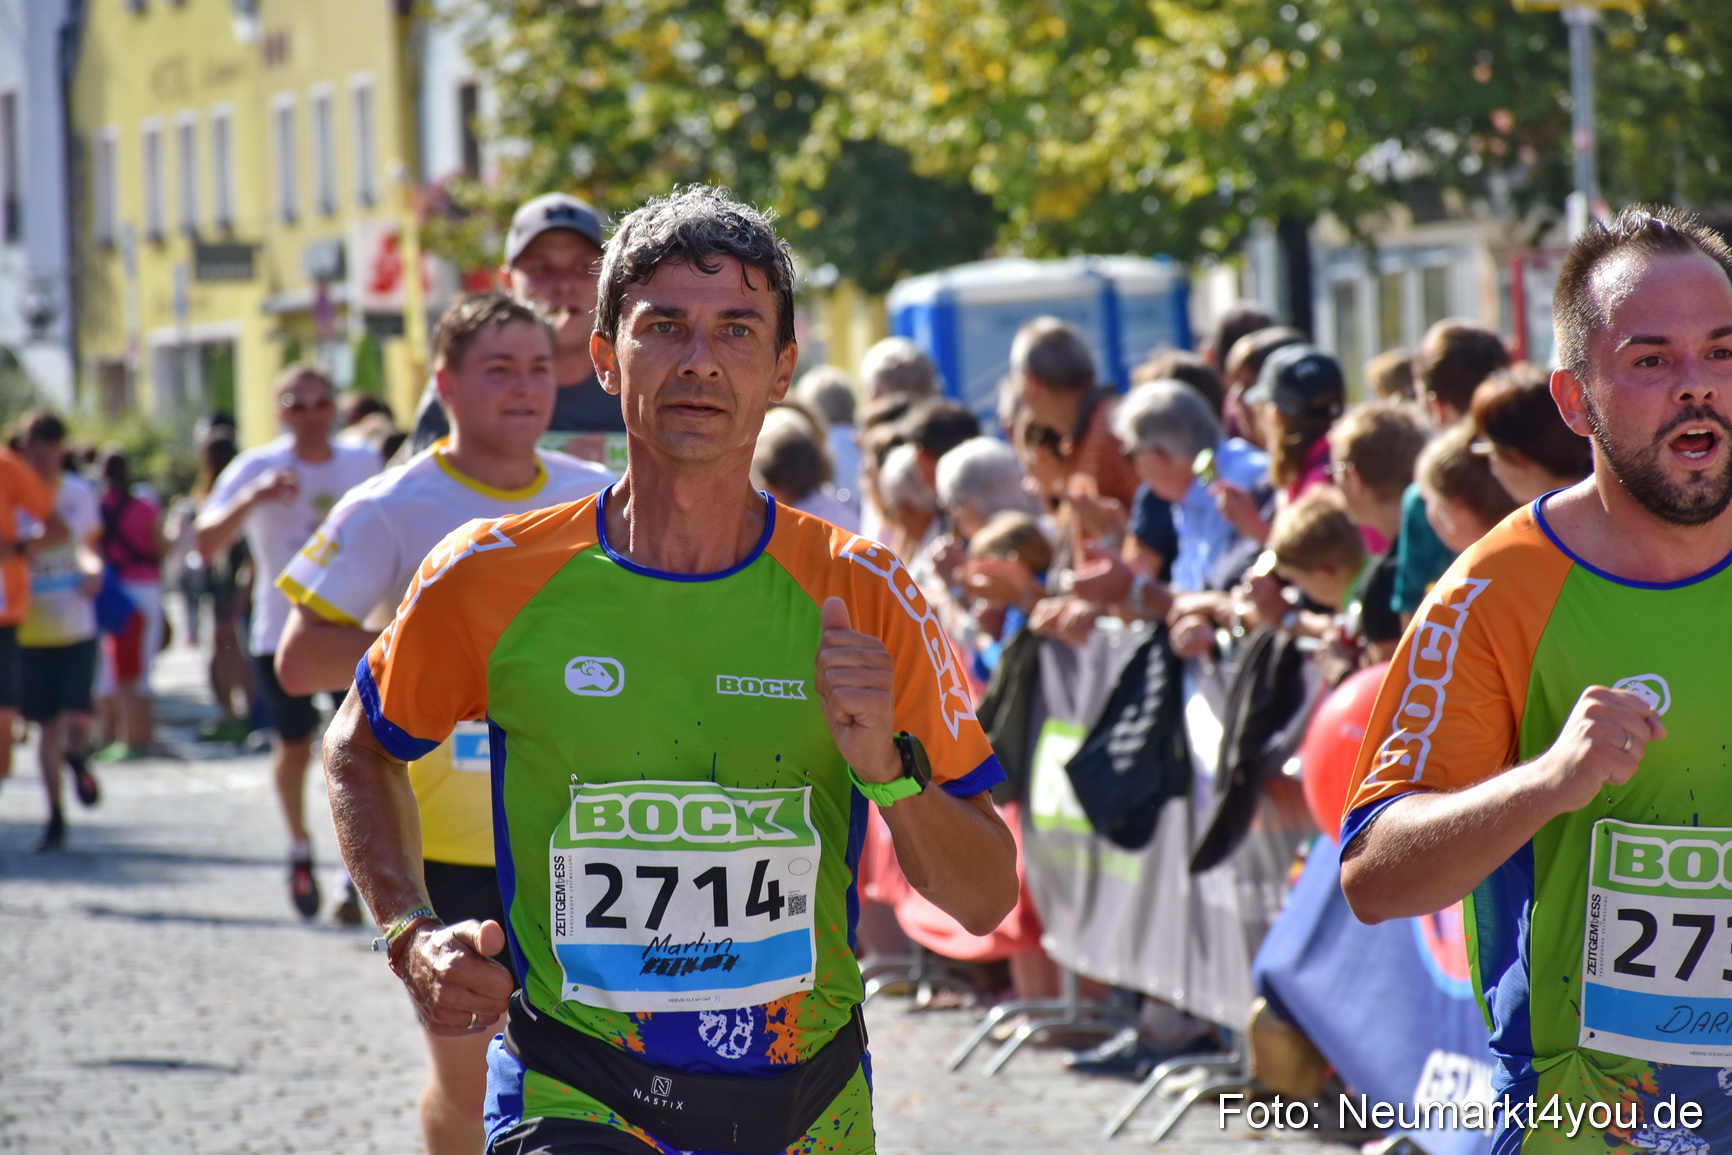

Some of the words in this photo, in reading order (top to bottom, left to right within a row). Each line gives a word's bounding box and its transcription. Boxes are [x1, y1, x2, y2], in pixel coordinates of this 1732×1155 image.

[839, 535, 978, 741] BOCK
[716, 674, 808, 700] BOCK
[1367, 578, 1492, 784] BOCK
[569, 792, 798, 843] BOCK
[1608, 832, 1732, 890] BO
[584, 859, 785, 931] 2714
[641, 931, 733, 960] Martin
[1613, 908, 1732, 982] 27
